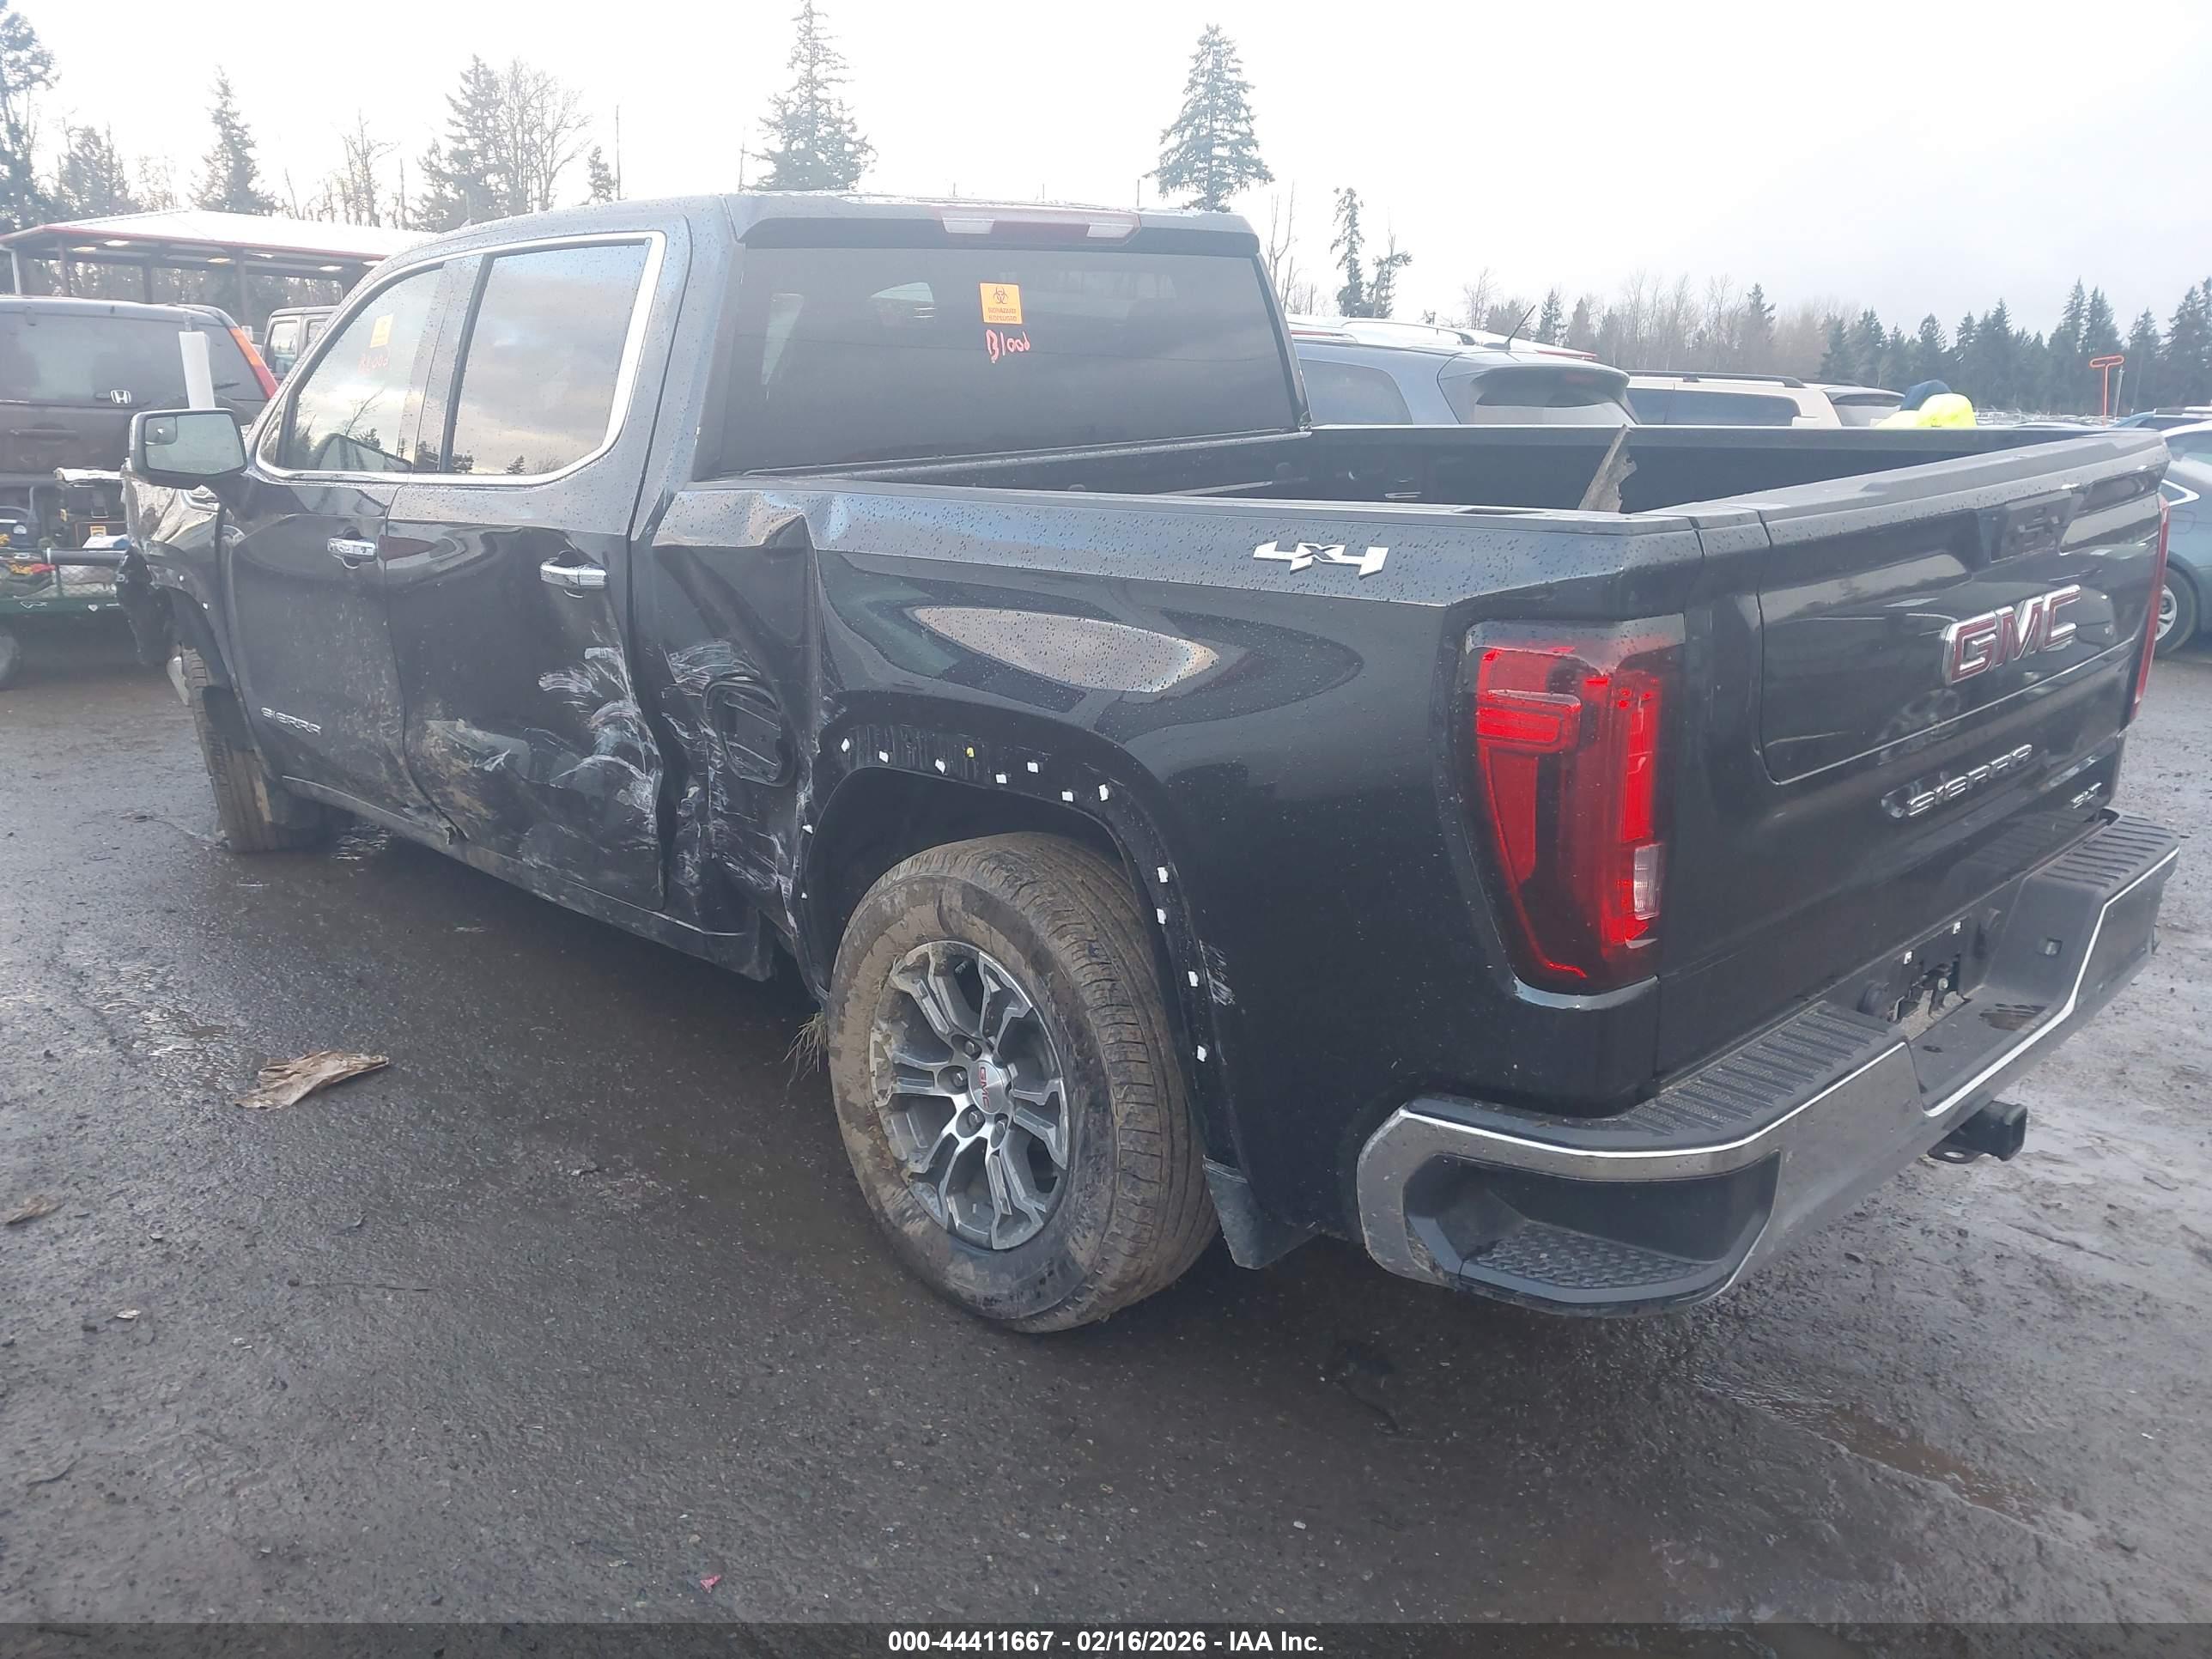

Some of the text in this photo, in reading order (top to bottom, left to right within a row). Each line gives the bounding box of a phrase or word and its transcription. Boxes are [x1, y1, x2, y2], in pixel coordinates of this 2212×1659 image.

[986, 330, 1030, 363] Blood
[1942, 584, 2081, 685] GMC
[1906, 744, 2033, 816] SIERRA
[980, 1066, 990, 1109] GMC
